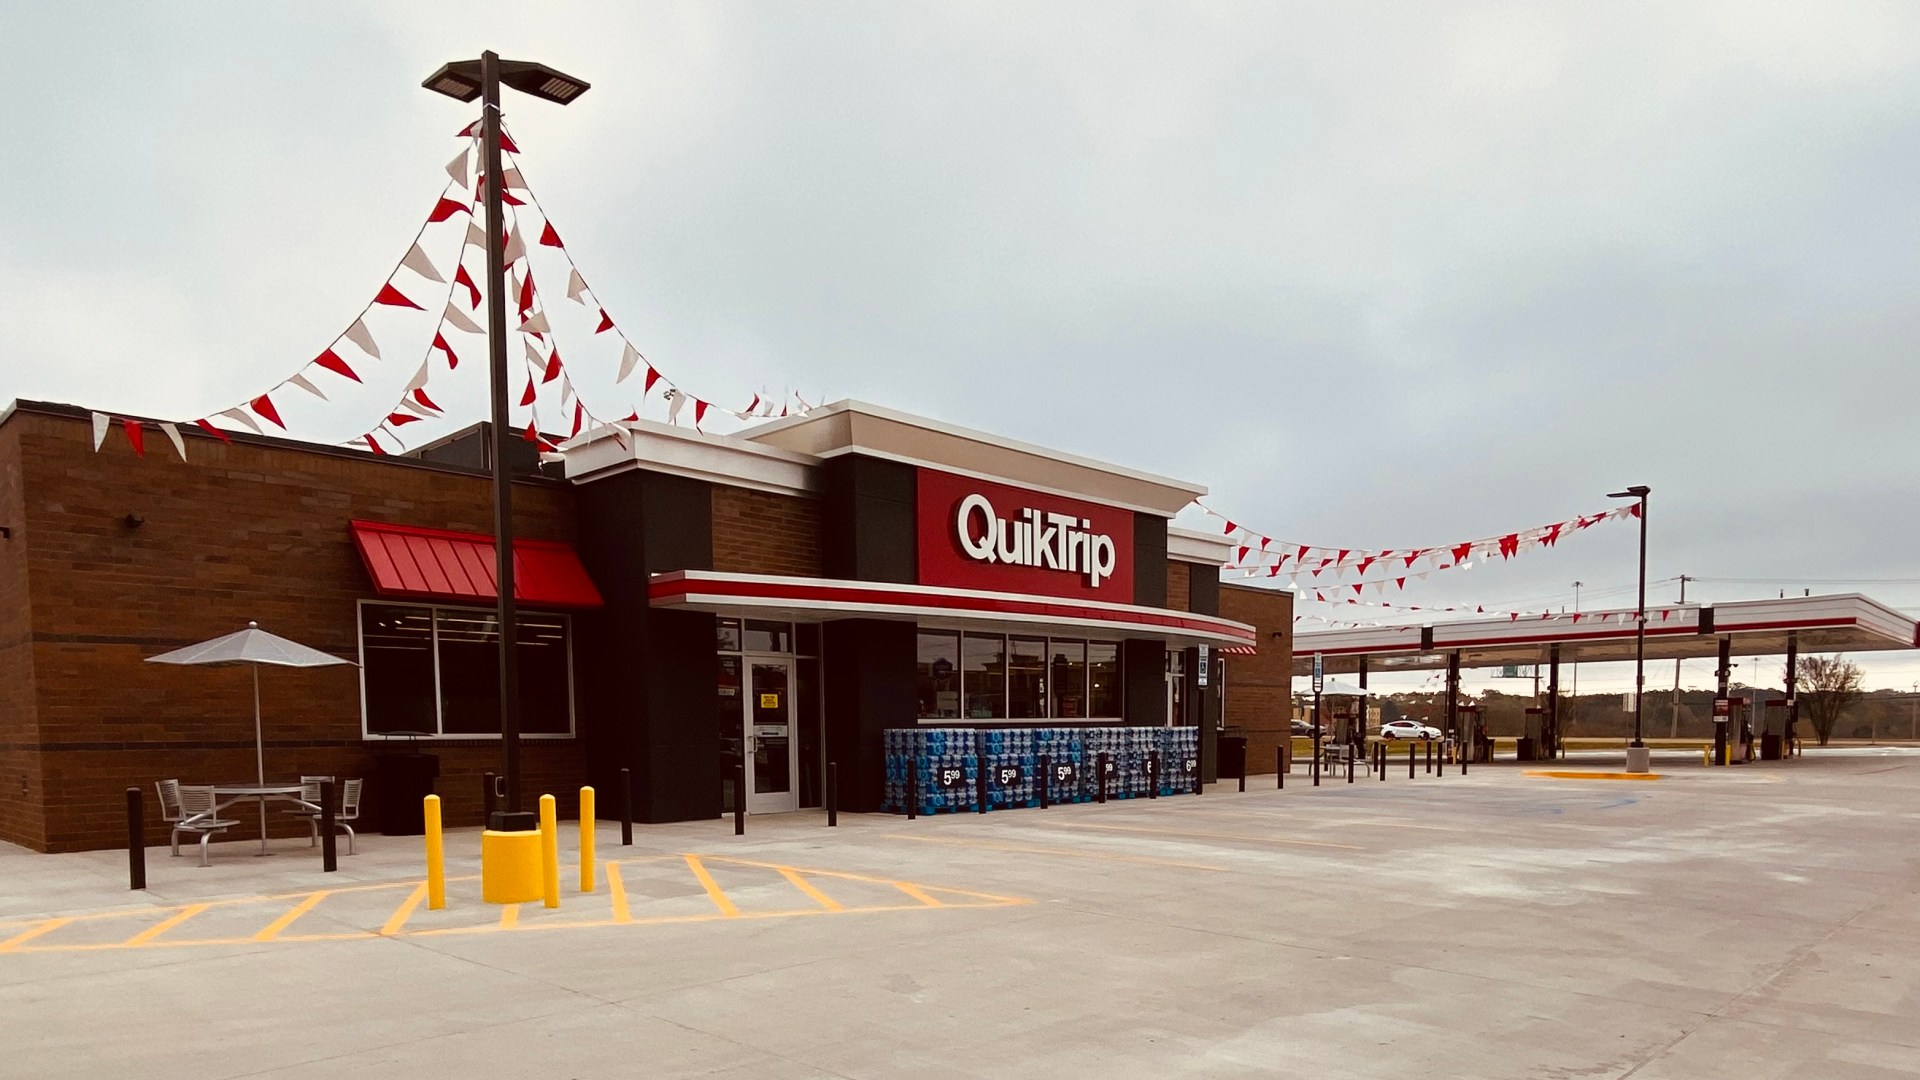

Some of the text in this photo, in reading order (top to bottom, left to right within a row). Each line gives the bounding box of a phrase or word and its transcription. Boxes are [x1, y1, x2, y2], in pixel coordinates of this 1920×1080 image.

[957, 493, 1116, 588] QuikTrip
[943, 769, 961, 785] 599
[1001, 769, 1017, 784] 599
[1057, 766, 1072, 780] 599
